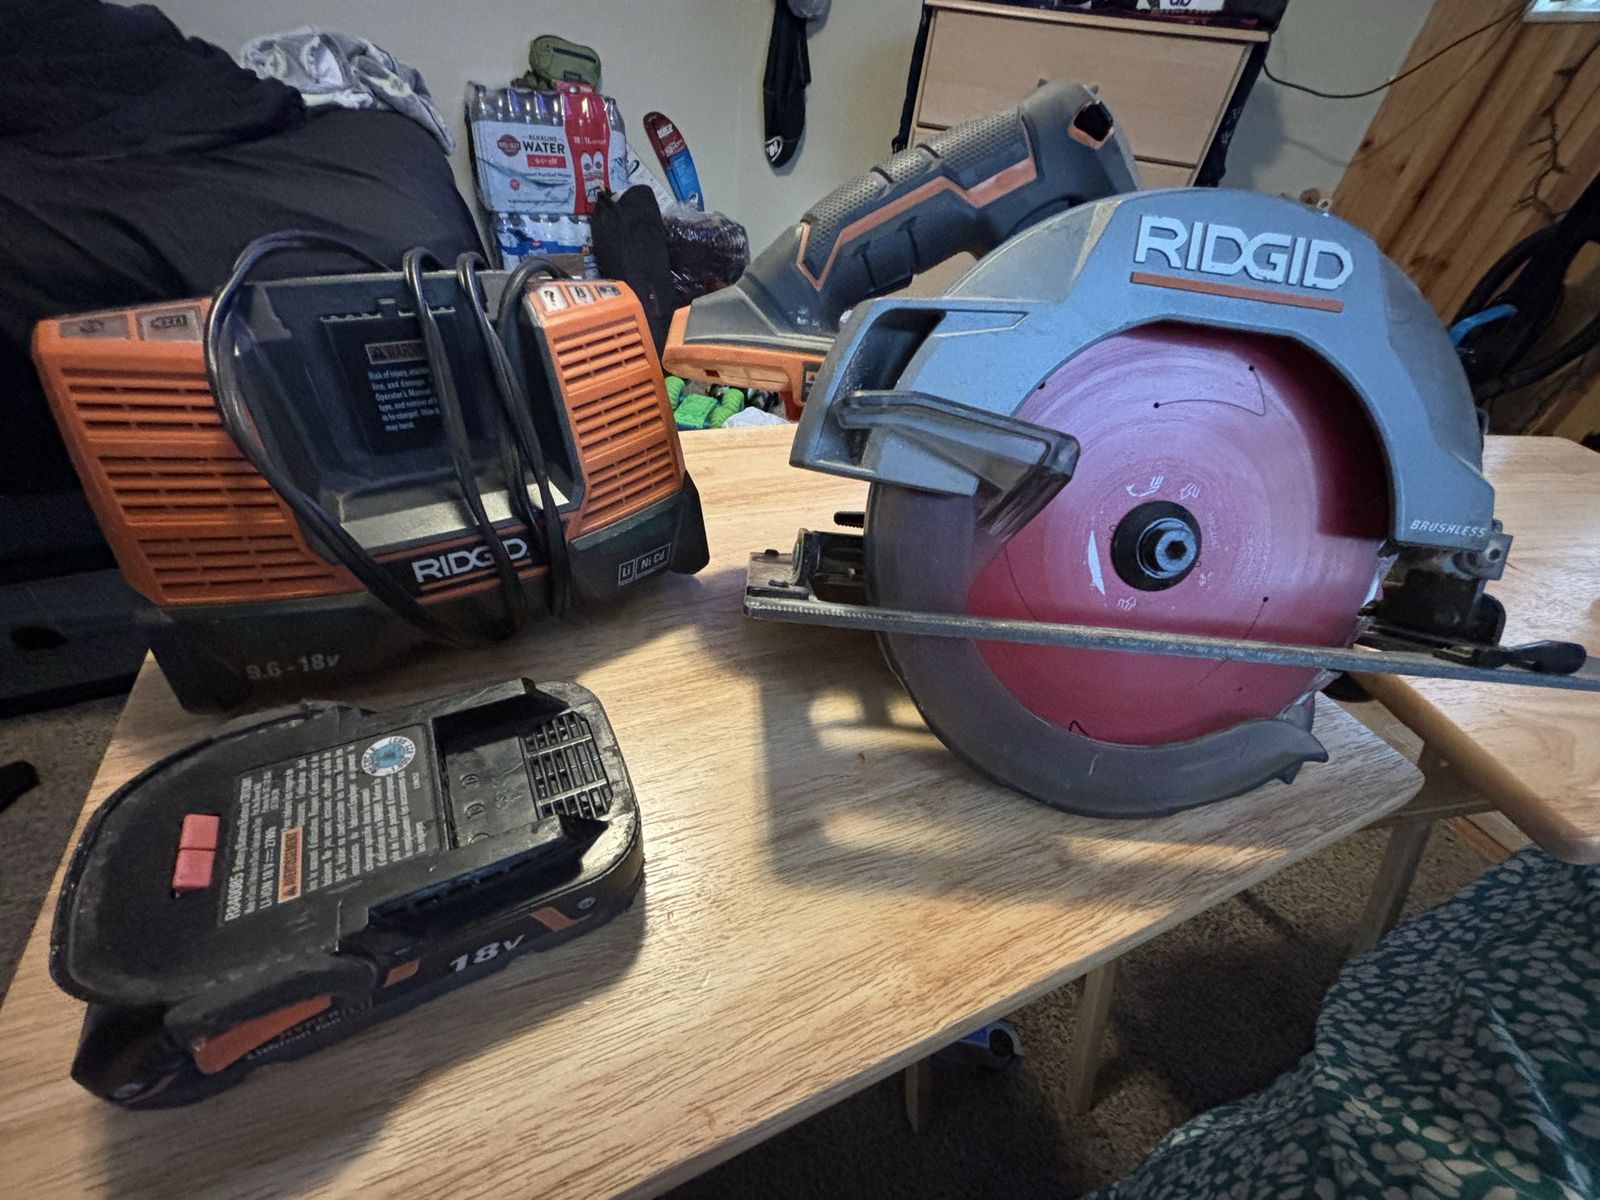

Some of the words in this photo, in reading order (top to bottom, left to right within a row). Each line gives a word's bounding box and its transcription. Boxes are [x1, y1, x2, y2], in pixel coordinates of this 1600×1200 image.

[522, 140, 566, 154] WATER
[1133, 214, 1354, 290] RIDGID
[1409, 519, 1489, 538] BRUSHLESS
[411, 537, 529, 584] RIDGD
